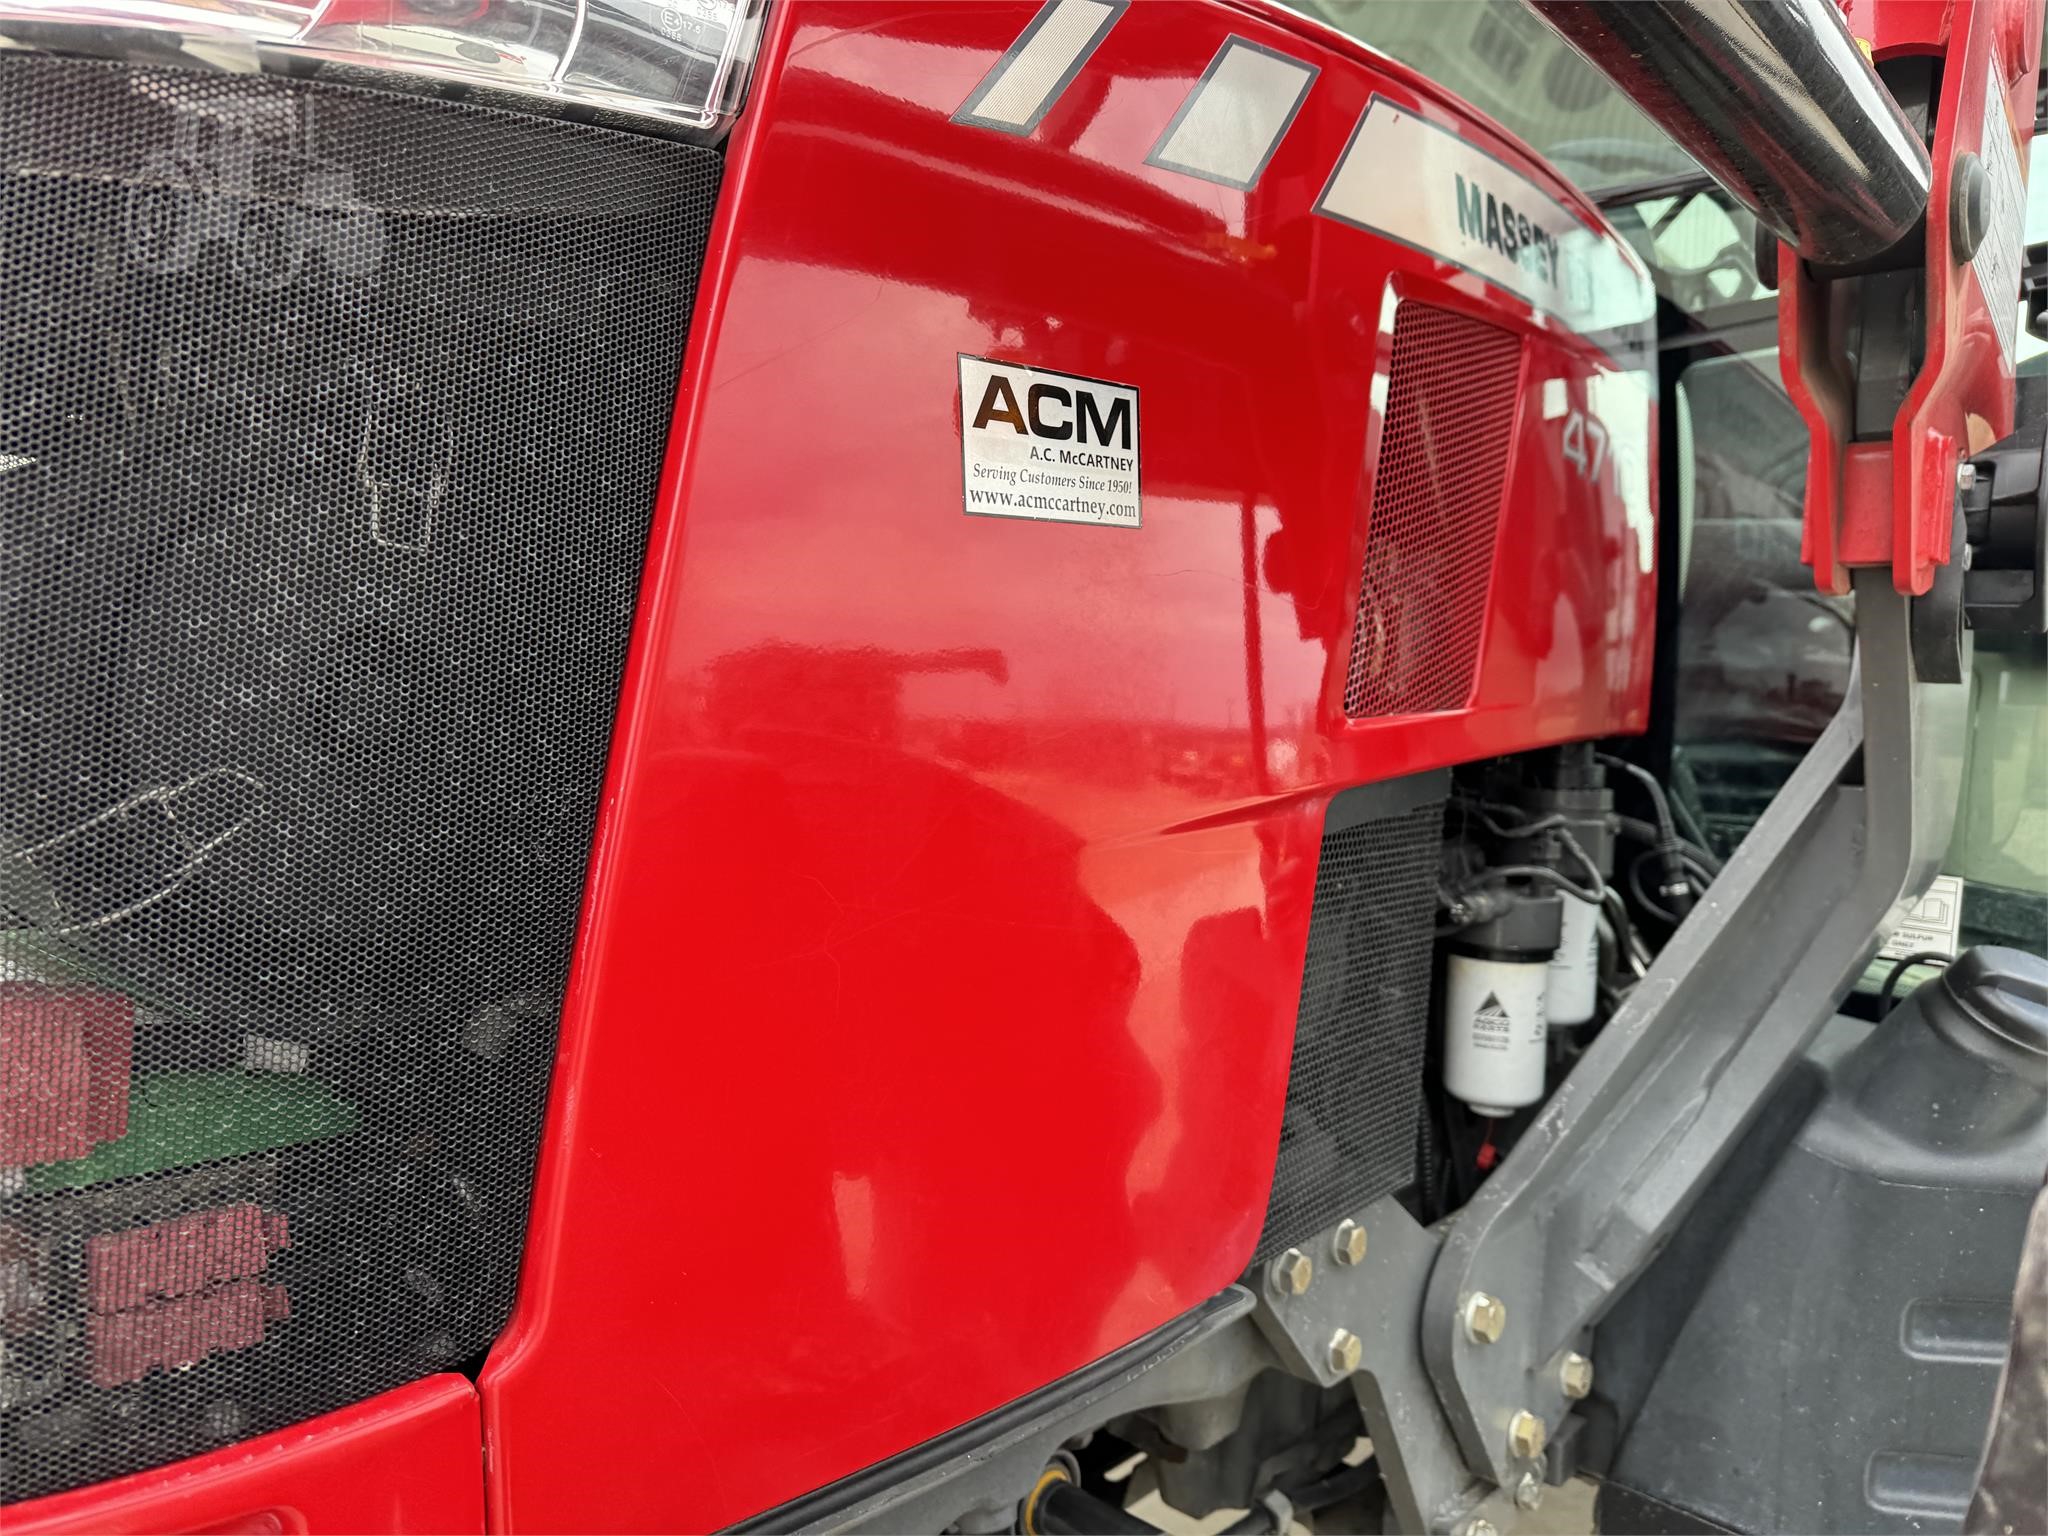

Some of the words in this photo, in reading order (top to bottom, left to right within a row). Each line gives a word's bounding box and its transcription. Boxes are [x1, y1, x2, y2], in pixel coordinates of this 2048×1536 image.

[972, 375, 1132, 450] ACM
[1030, 446, 1056, 463] A.C.
[1059, 450, 1134, 472] McCARTNEY
[973, 463, 1016, 485] Serving
[1019, 469, 1076, 488] Customers
[1078, 476, 1105, 491] Since
[1107, 480, 1132, 494] 1950!
[970, 489, 1136, 520] www.acmccartney.com
